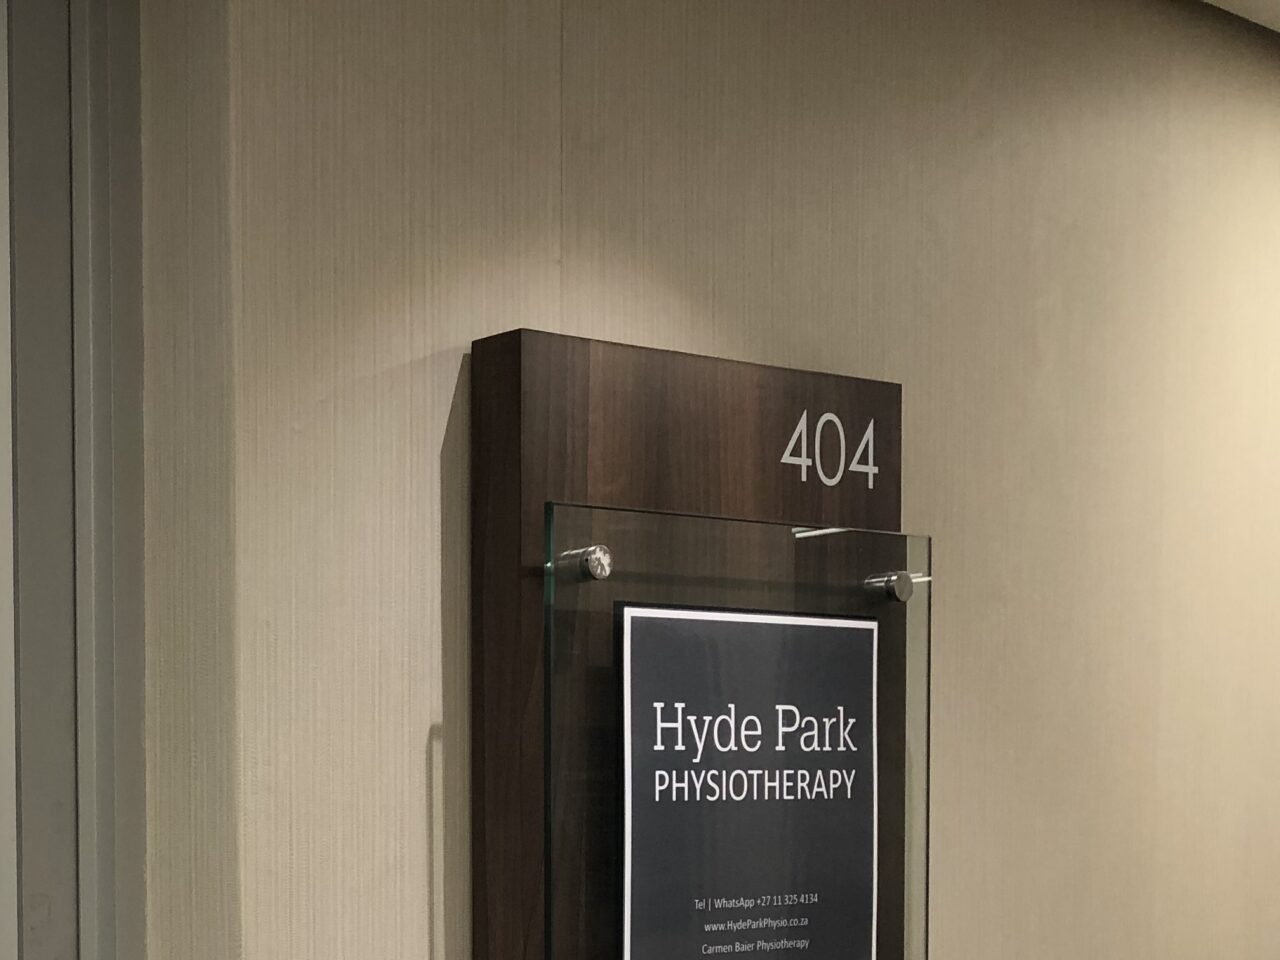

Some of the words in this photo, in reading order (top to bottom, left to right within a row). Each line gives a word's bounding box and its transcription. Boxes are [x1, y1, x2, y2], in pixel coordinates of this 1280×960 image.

[780, 409, 879, 489] 404
[653, 702, 762, 763] Hyde
[775, 704, 858, 752] Park
[654, 769, 856, 802] PHYSIOTHERAPY
[694, 899, 706, 910] Tel
[714, 897, 755, 909] WhatsApp
[757, 895, 771, 907] +27
[773, 895, 782, 906] 11
[784, 894, 798, 905] 325
[800, 893, 818, 904] 4134
[704, 917, 809, 932] www.HydeParkPhysio.co.za
[702, 944, 733, 955] Carmen
[735, 941, 755, 952] Baier
[756, 938, 810, 952] Physiotherapy
